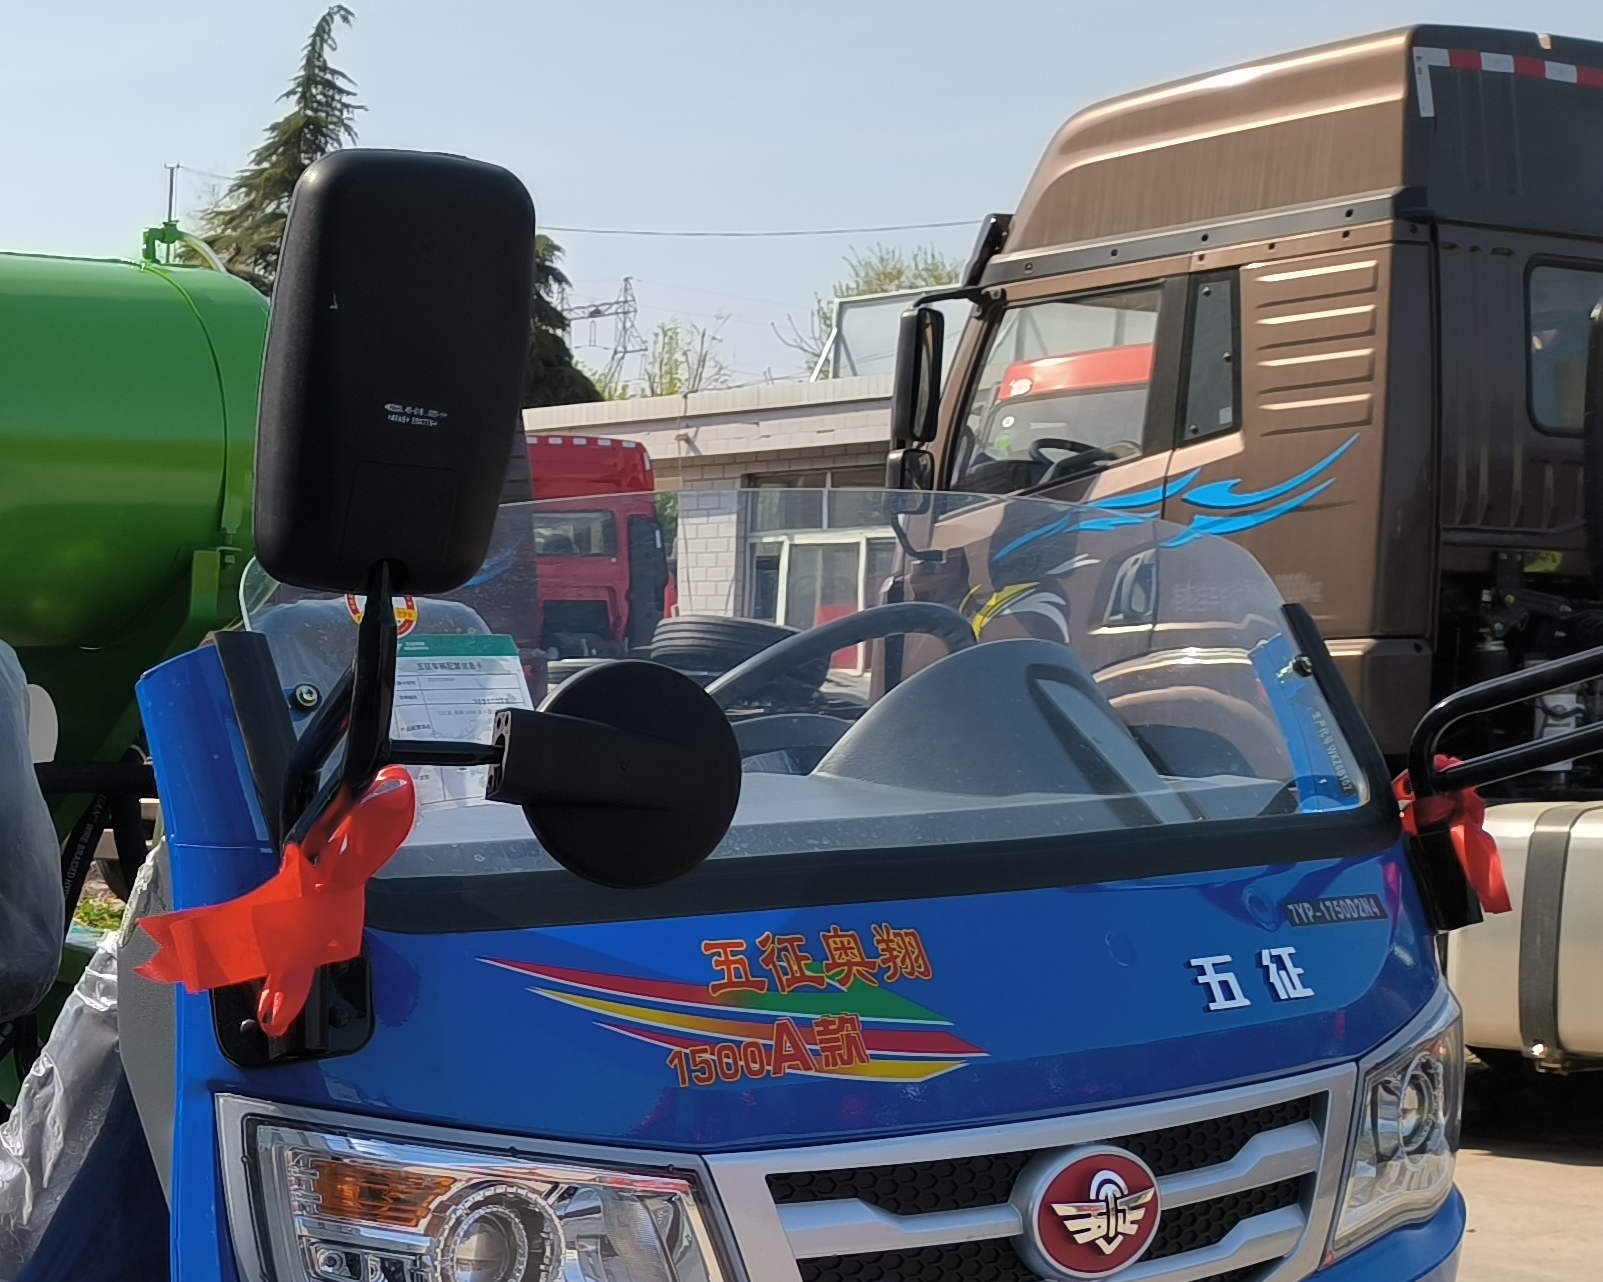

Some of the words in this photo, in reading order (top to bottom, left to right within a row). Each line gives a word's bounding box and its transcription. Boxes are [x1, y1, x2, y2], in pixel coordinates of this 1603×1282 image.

[1287, 898, 1381, 924] 7YP-1750D2N4
[701, 923, 932, 997] 五征奥翔
[1189, 946, 1315, 1011] 五征
[666, 1012, 871, 1088] 1500A款
